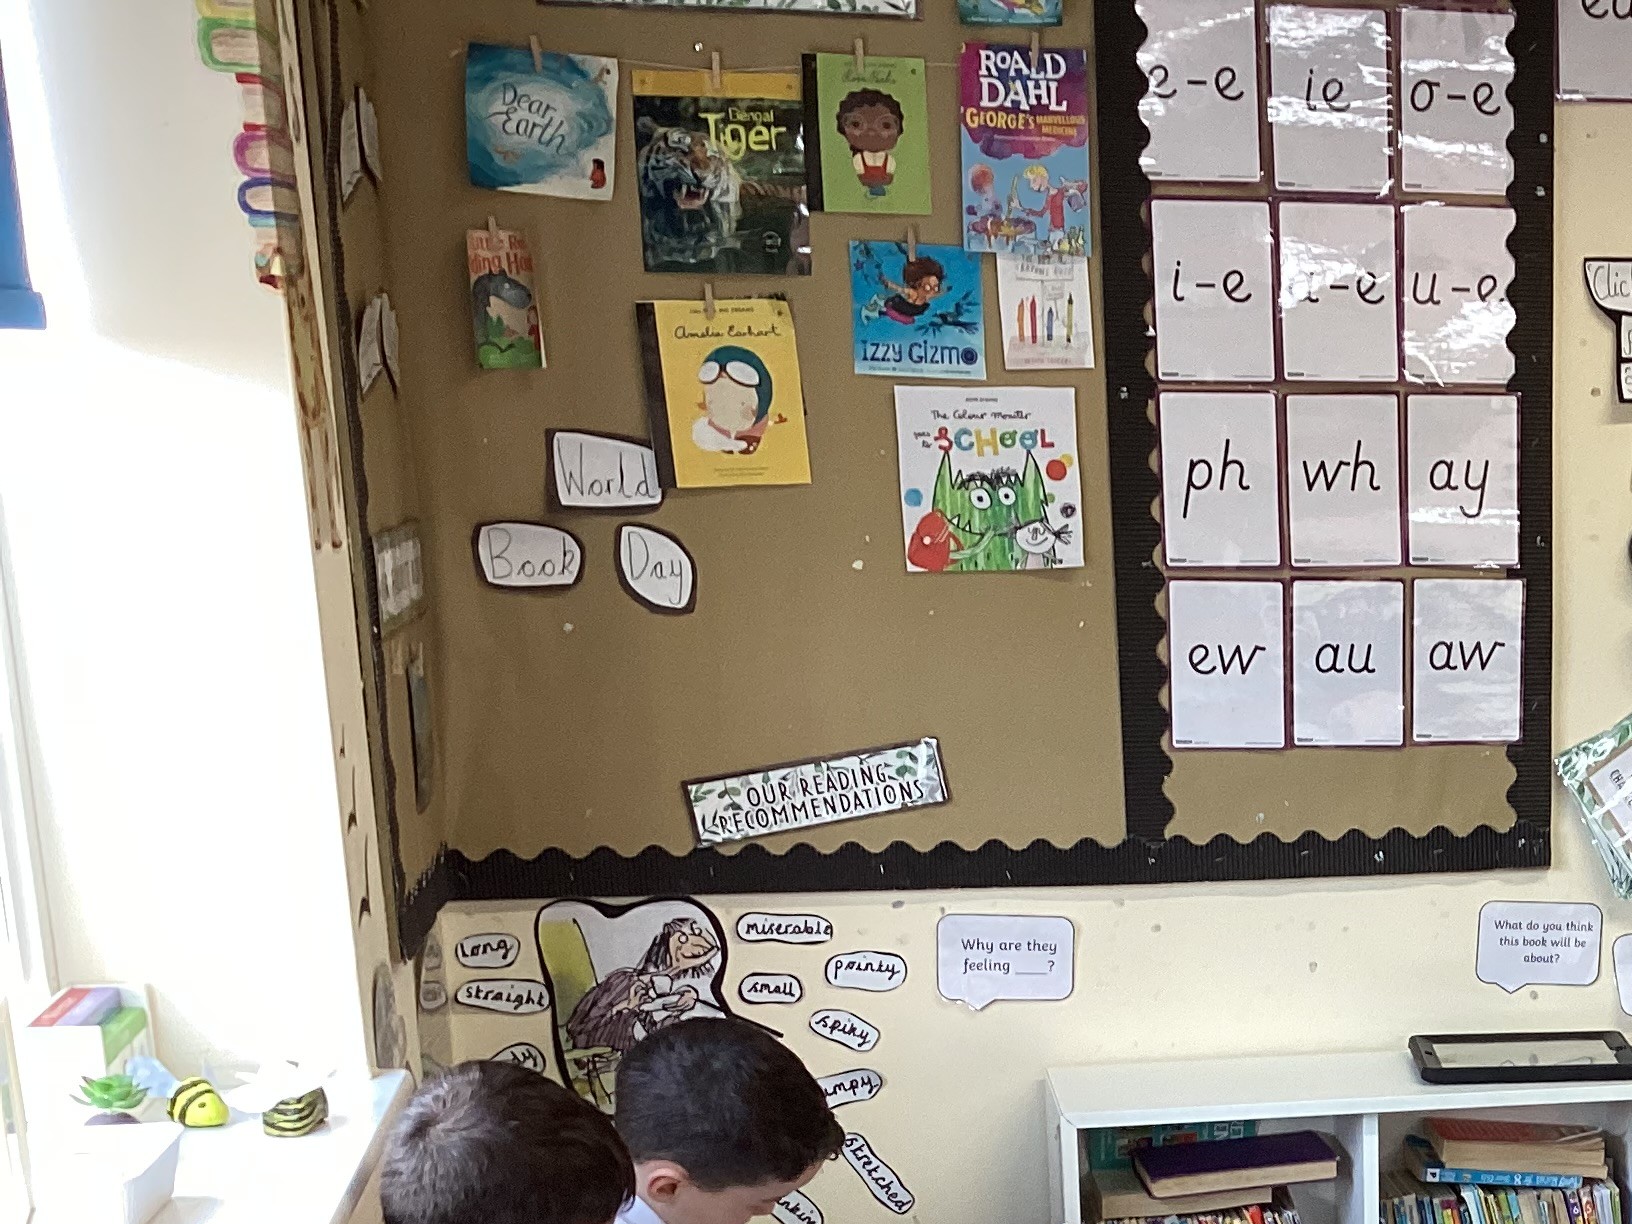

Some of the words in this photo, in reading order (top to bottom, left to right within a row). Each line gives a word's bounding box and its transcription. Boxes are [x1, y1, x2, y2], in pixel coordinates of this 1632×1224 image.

[979, 49, 1067, 79] ROALD
[502, 82, 557, 120] Dear
[979, 77, 1068, 111] DAHL
[1410, 78, 1501, 115] o-e
[487, 107, 575, 156] Earth
[728, 108, 774, 124] Bengal
[698, 112, 787, 162] Tiger
[1172, 260, 1252, 302] i-e
[934, 426, 1055, 457] SCHOOL
[556, 437, 660, 499] World
[1183, 438, 1250, 518] ph
[1302, 440, 1381, 492] wh
[1429, 459, 1490, 518] ay
[487, 527, 575, 580] Book
[628, 531, 683, 605] Day
[1187, 642, 1266, 675] ew
[1315, 643, 1376, 674] au
[1429, 640, 1505, 672] aw
[745, 781, 793, 807] OUR
[800, 763, 887, 796] READING
[718, 779, 924, 834] RECOMMENDATIONS
[745, 917, 833, 937] miserable
[1494, 919, 1523, 931] What
[1526, 919, 1540, 931] do
[1543, 922, 1562, 934] you
[1566, 921, 1594, 932] think
[1499, 937, 1519, 947] this
[1522, 937, 1547, 947] book
[1550, 937, 1570, 948] will
[1574, 938, 1587, 948] be
[458, 938, 514, 961] long
[961, 937, 994, 954] Why
[999, 941, 1022, 951] are
[1027, 938, 1057, 956] they
[1523, 952, 1561, 964] about?
[834, 957, 901, 981] pointy
[962, 958, 1011, 975] feeling
[464, 984, 546, 1010] straight
[747, 980, 796, 996] small
[815, 1015, 871, 1047] spiky
